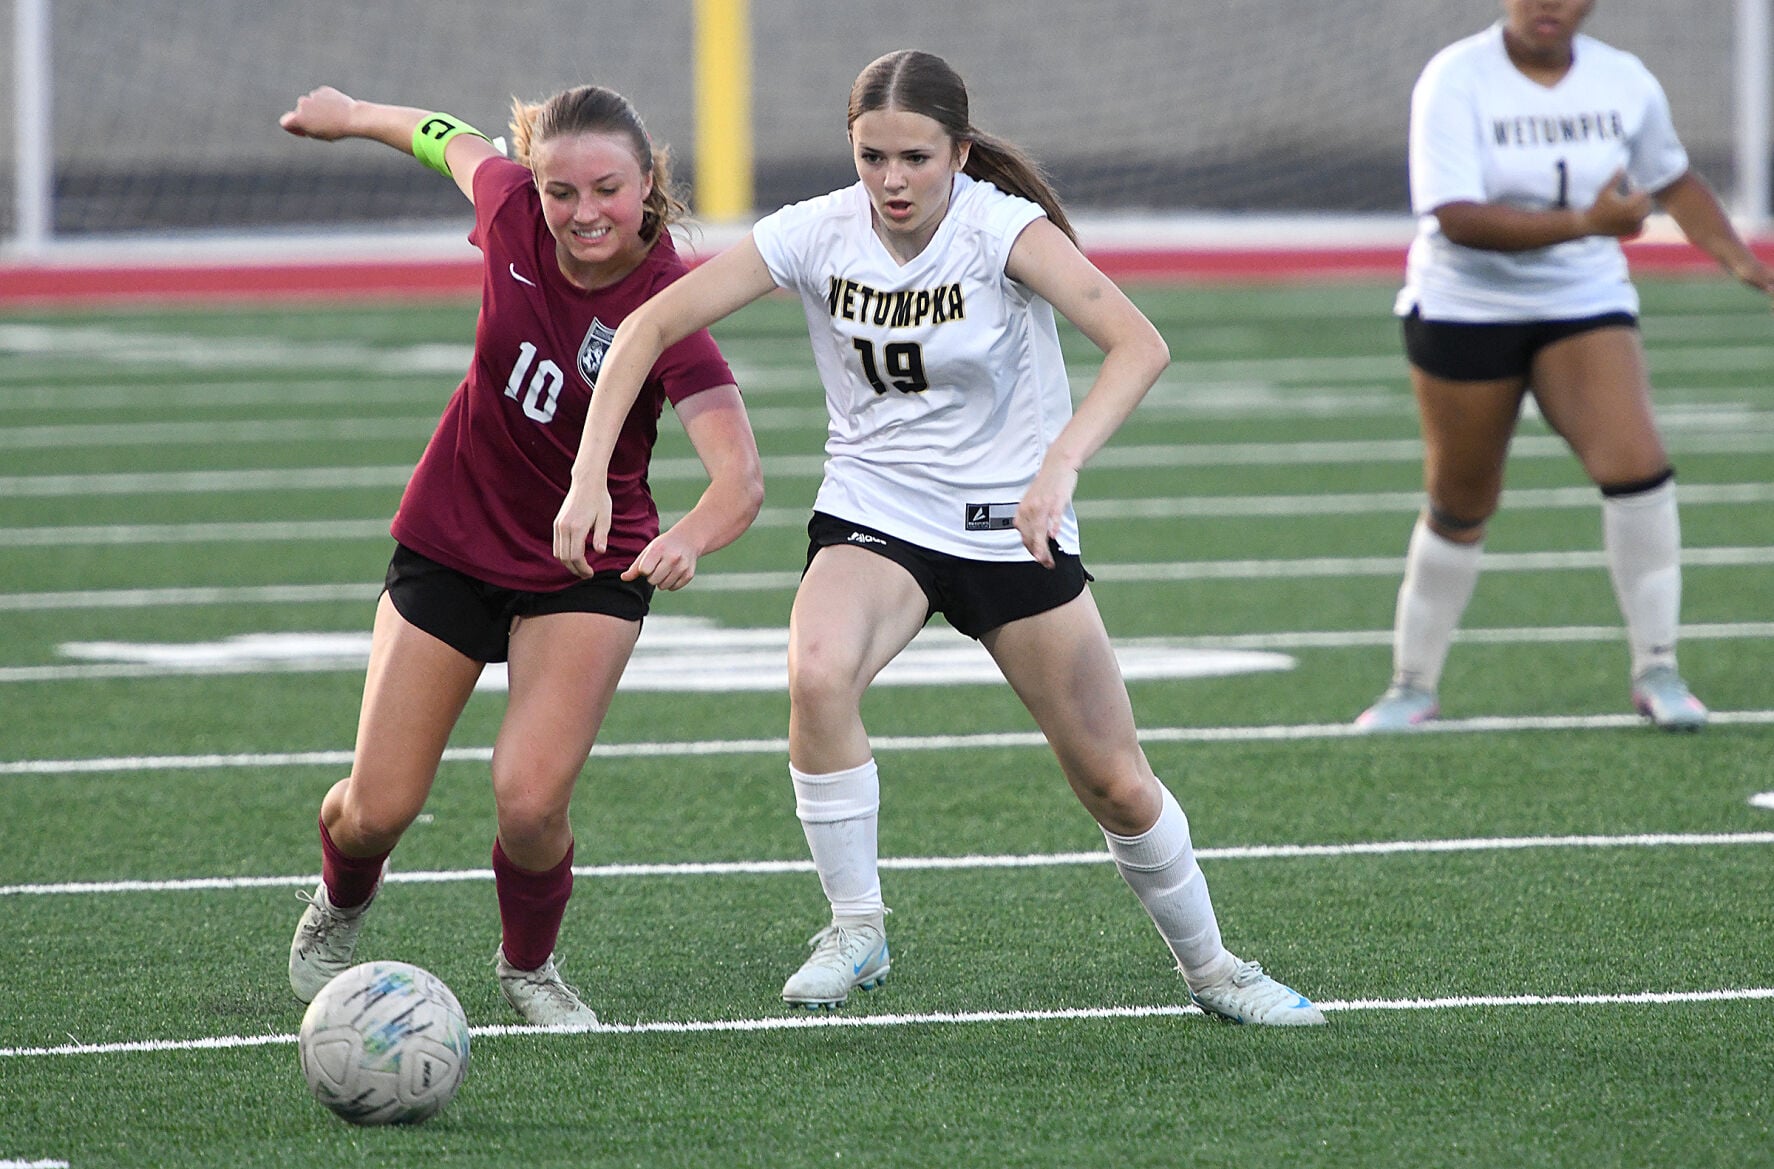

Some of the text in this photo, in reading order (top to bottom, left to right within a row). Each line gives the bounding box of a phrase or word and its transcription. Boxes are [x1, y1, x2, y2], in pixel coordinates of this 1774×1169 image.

[422, 119, 456, 139] C
[1554, 158, 1570, 209] 1
[504, 341, 564, 424] 10
[852, 336, 929, 395] 19
